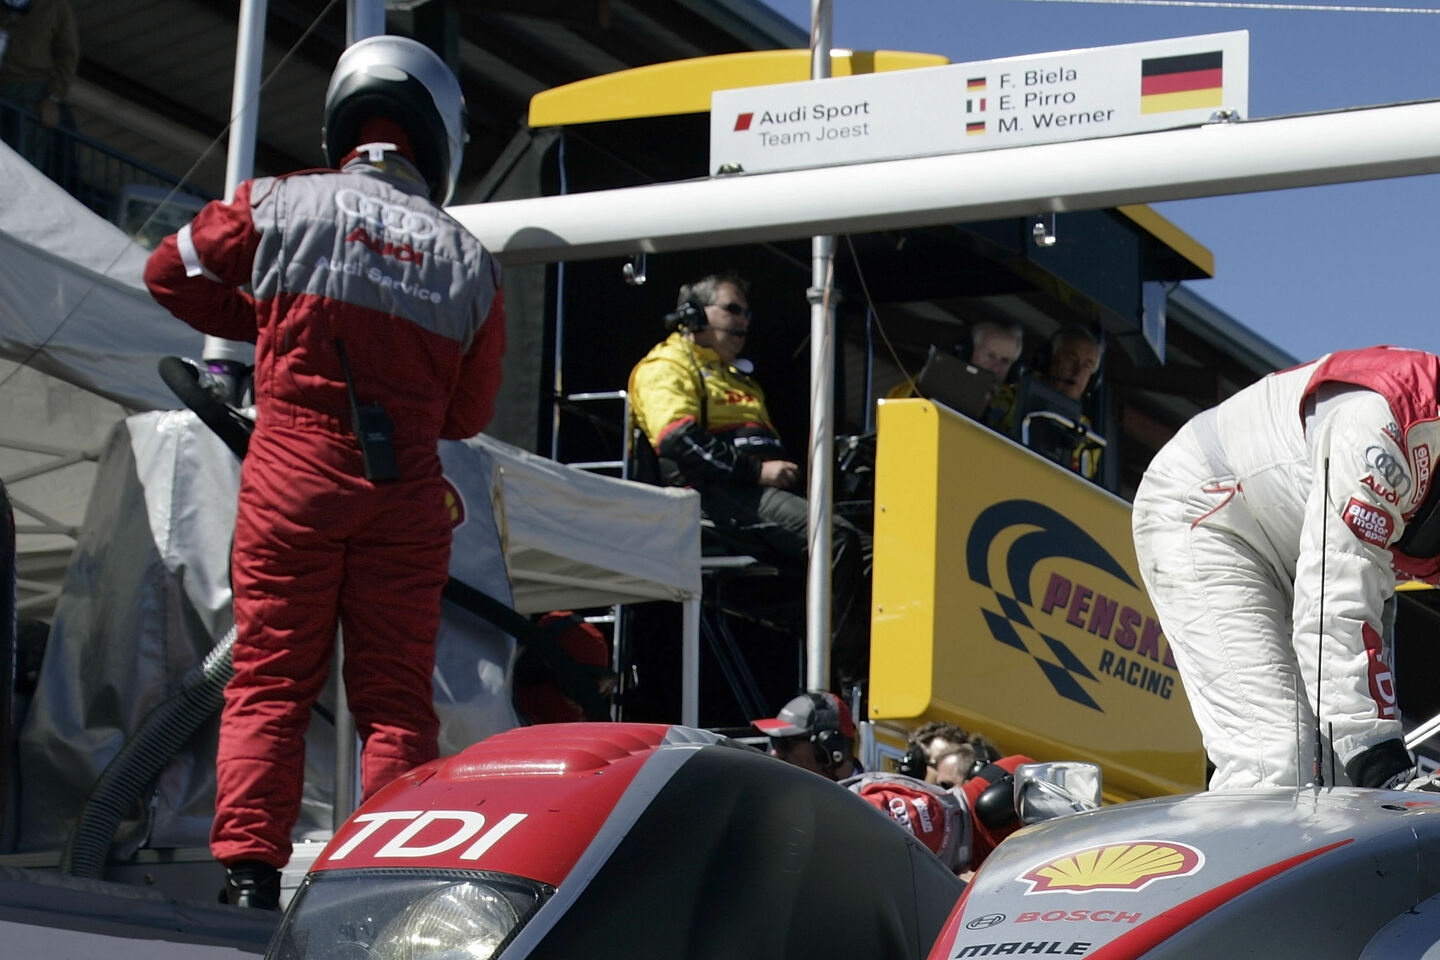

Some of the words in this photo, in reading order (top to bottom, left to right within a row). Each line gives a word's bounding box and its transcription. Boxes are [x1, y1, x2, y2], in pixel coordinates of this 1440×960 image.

[1000, 73, 1015, 88] F.
[1025, 67, 1077, 86] Biela
[1000, 95, 1015, 110] E.
[1025, 91, 1076, 108] Pirro
[760, 106, 806, 125] Audi
[813, 102, 869, 121] Sport
[998, 116, 1023, 133] M.
[1032, 109, 1115, 129] Werner
[759, 131, 810, 147] Team
[816, 123, 869, 141] Joest
[345, 226, 423, 267] Audi
[315, 257, 361, 276] Audi
[367, 267, 442, 303] Service
[1360, 475, 1399, 506] Audi
[1348, 504, 1387, 527] auto
[1099, 650, 1175, 700] RACING
[328, 811, 528, 860] TDI
[1014, 910, 1142, 924] BOSCH
[955, 941, 1092, 959] MAHLE
